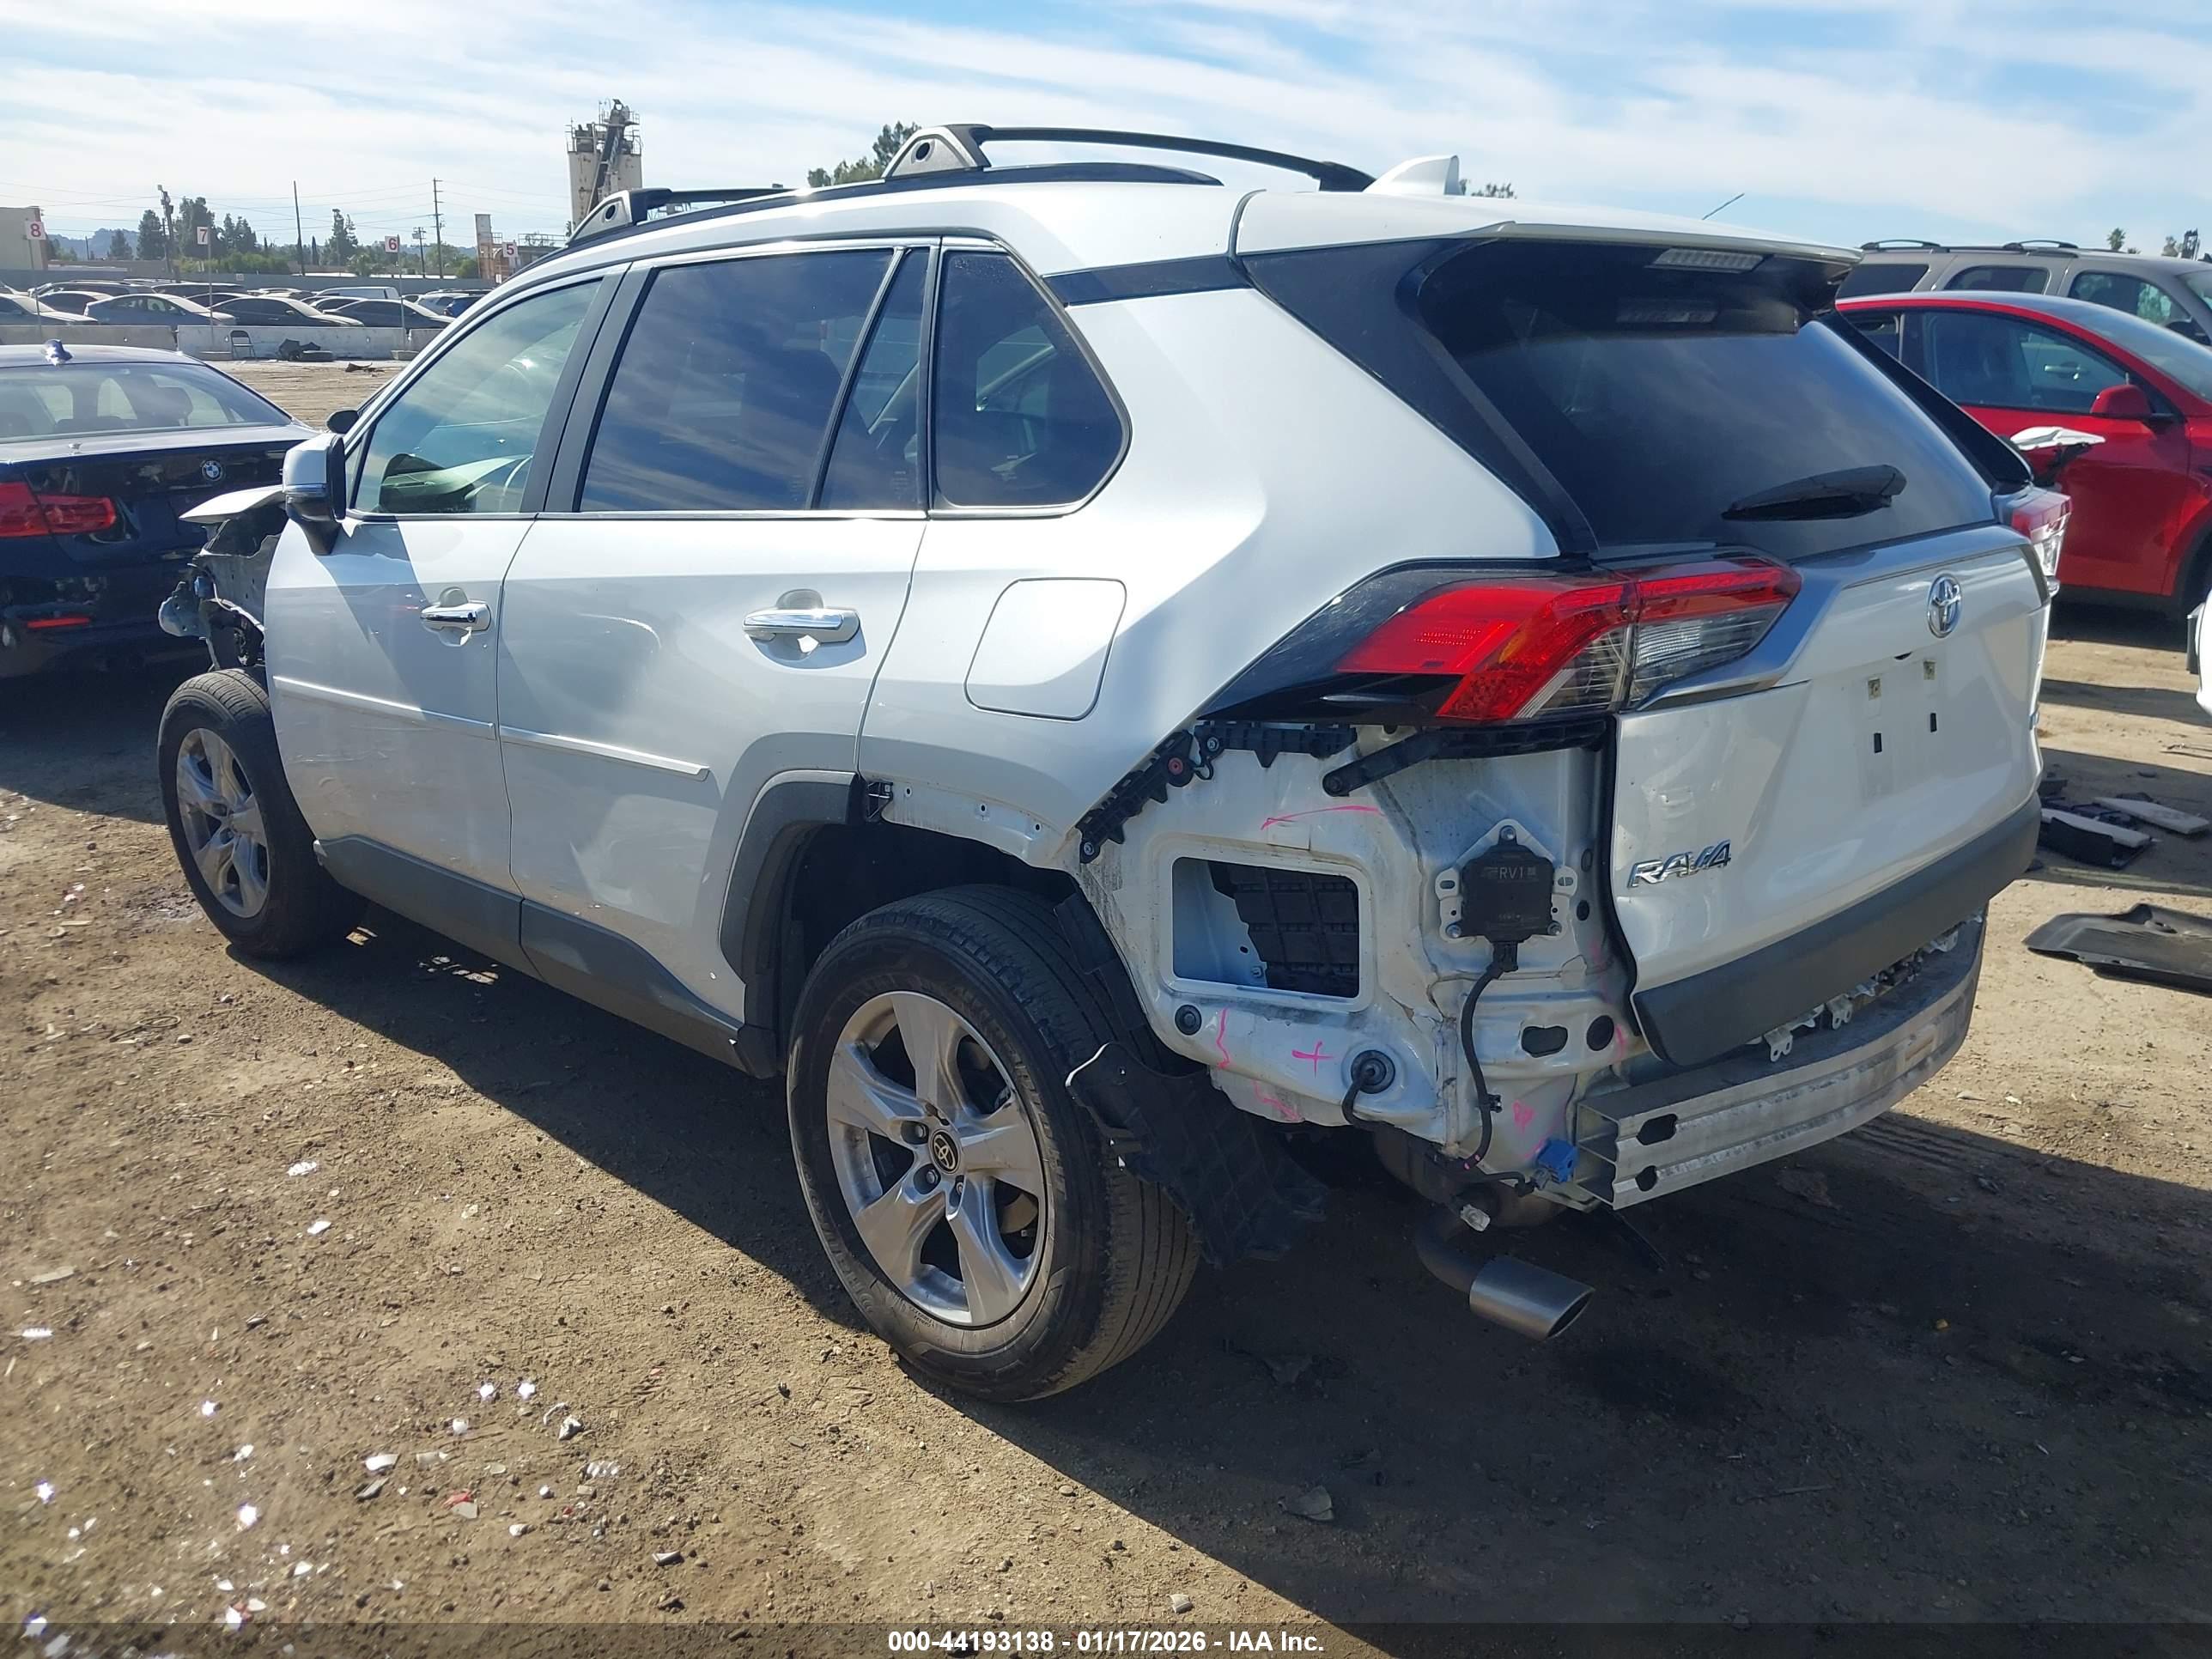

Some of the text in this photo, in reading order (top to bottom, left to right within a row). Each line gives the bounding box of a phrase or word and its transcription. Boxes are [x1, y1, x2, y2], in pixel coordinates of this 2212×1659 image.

[30, 223, 41, 237] 8
[199, 228, 208, 242] 7
[388, 237, 398, 251] 6
[506, 243, 515, 256] 5
[1627, 839, 1731, 888] RAV4
[1499, 866, 1524, 880] RV1
